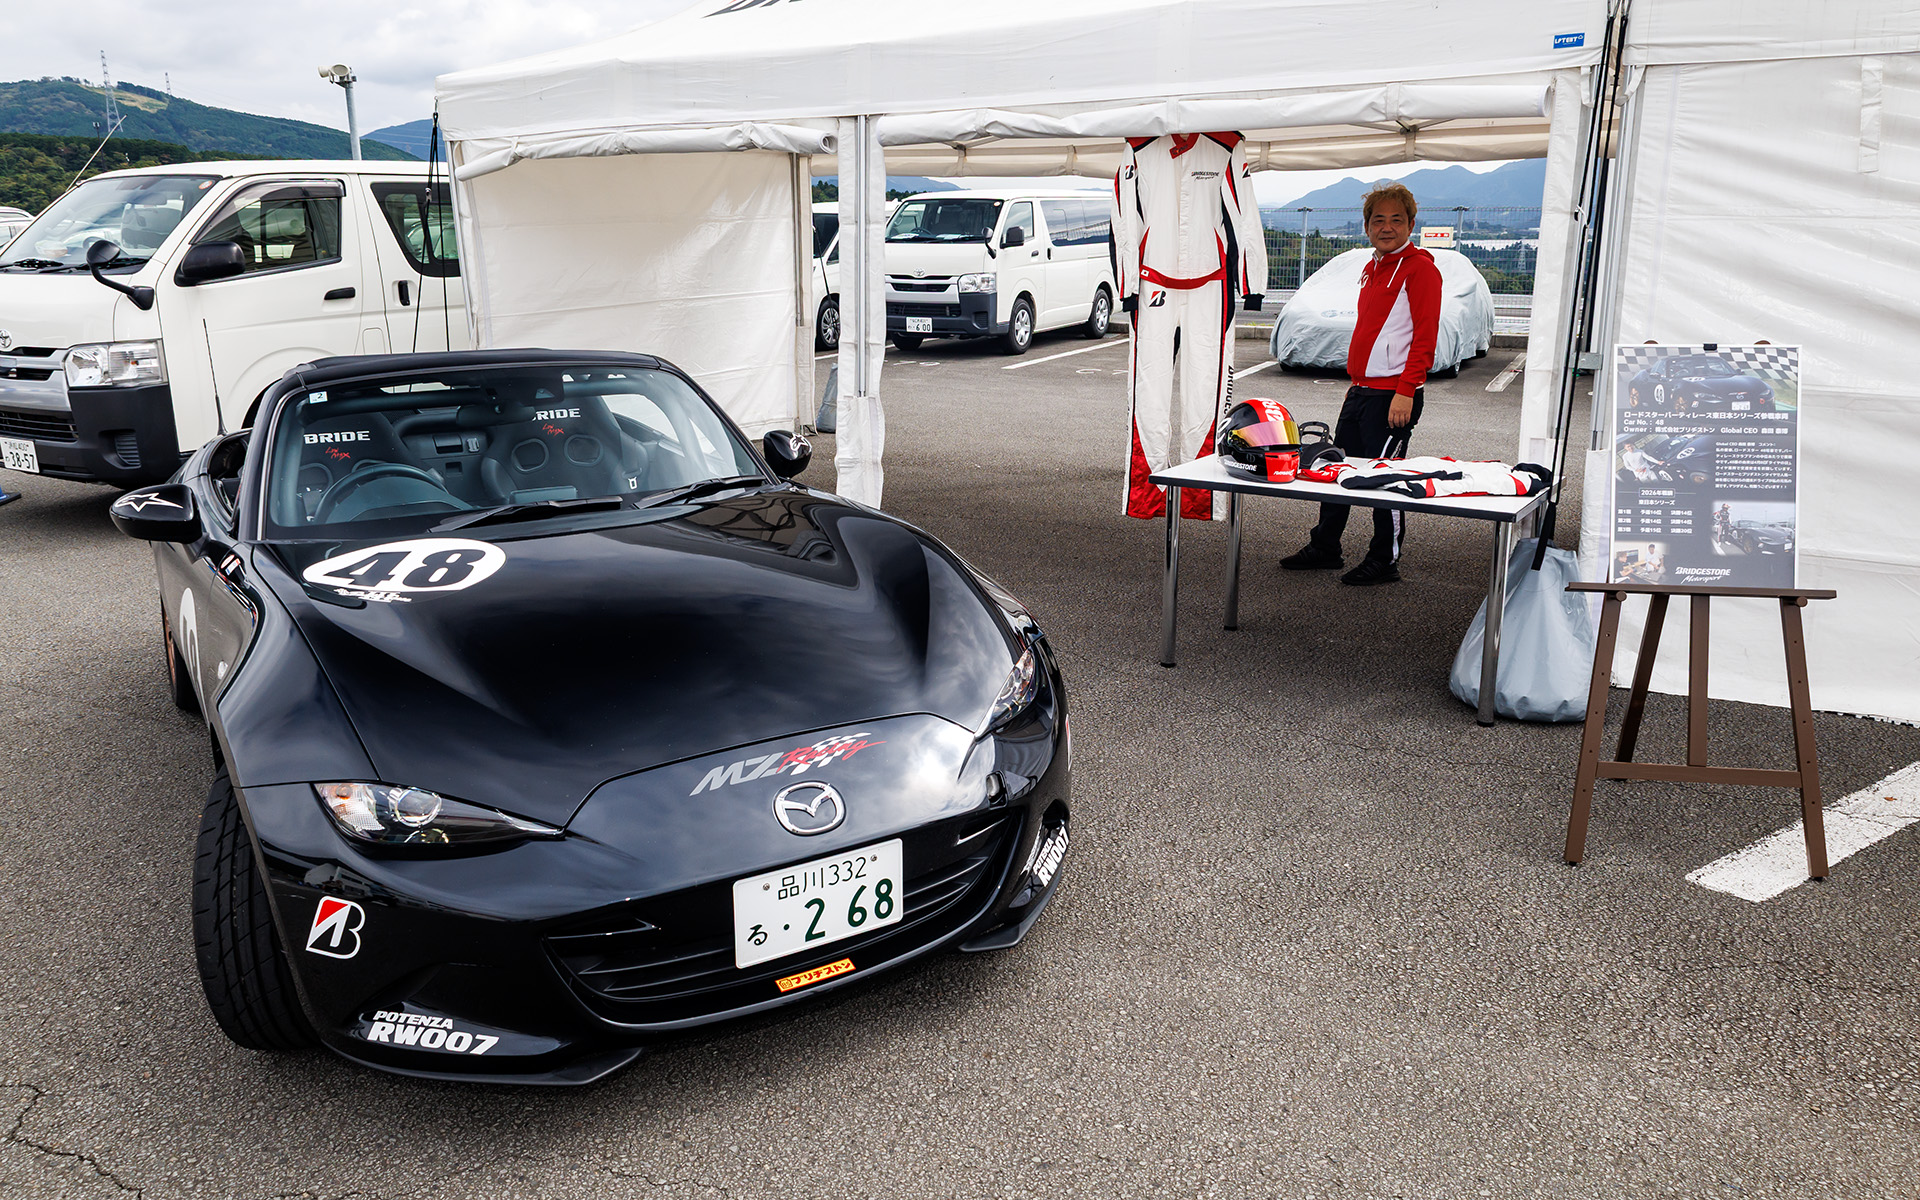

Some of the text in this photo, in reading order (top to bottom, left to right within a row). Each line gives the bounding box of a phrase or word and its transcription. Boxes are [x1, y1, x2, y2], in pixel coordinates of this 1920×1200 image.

[532, 408, 581, 421] RIDE
[303, 430, 371, 444] BRIDE
[323, 549, 486, 588] 48
[1675, 566, 1731, 576] BRIDGESTONE
[1037, 826, 1070, 888] RW007
[372, 1010, 453, 1030] POTENZA
[367, 1021, 500, 1055] RW007
